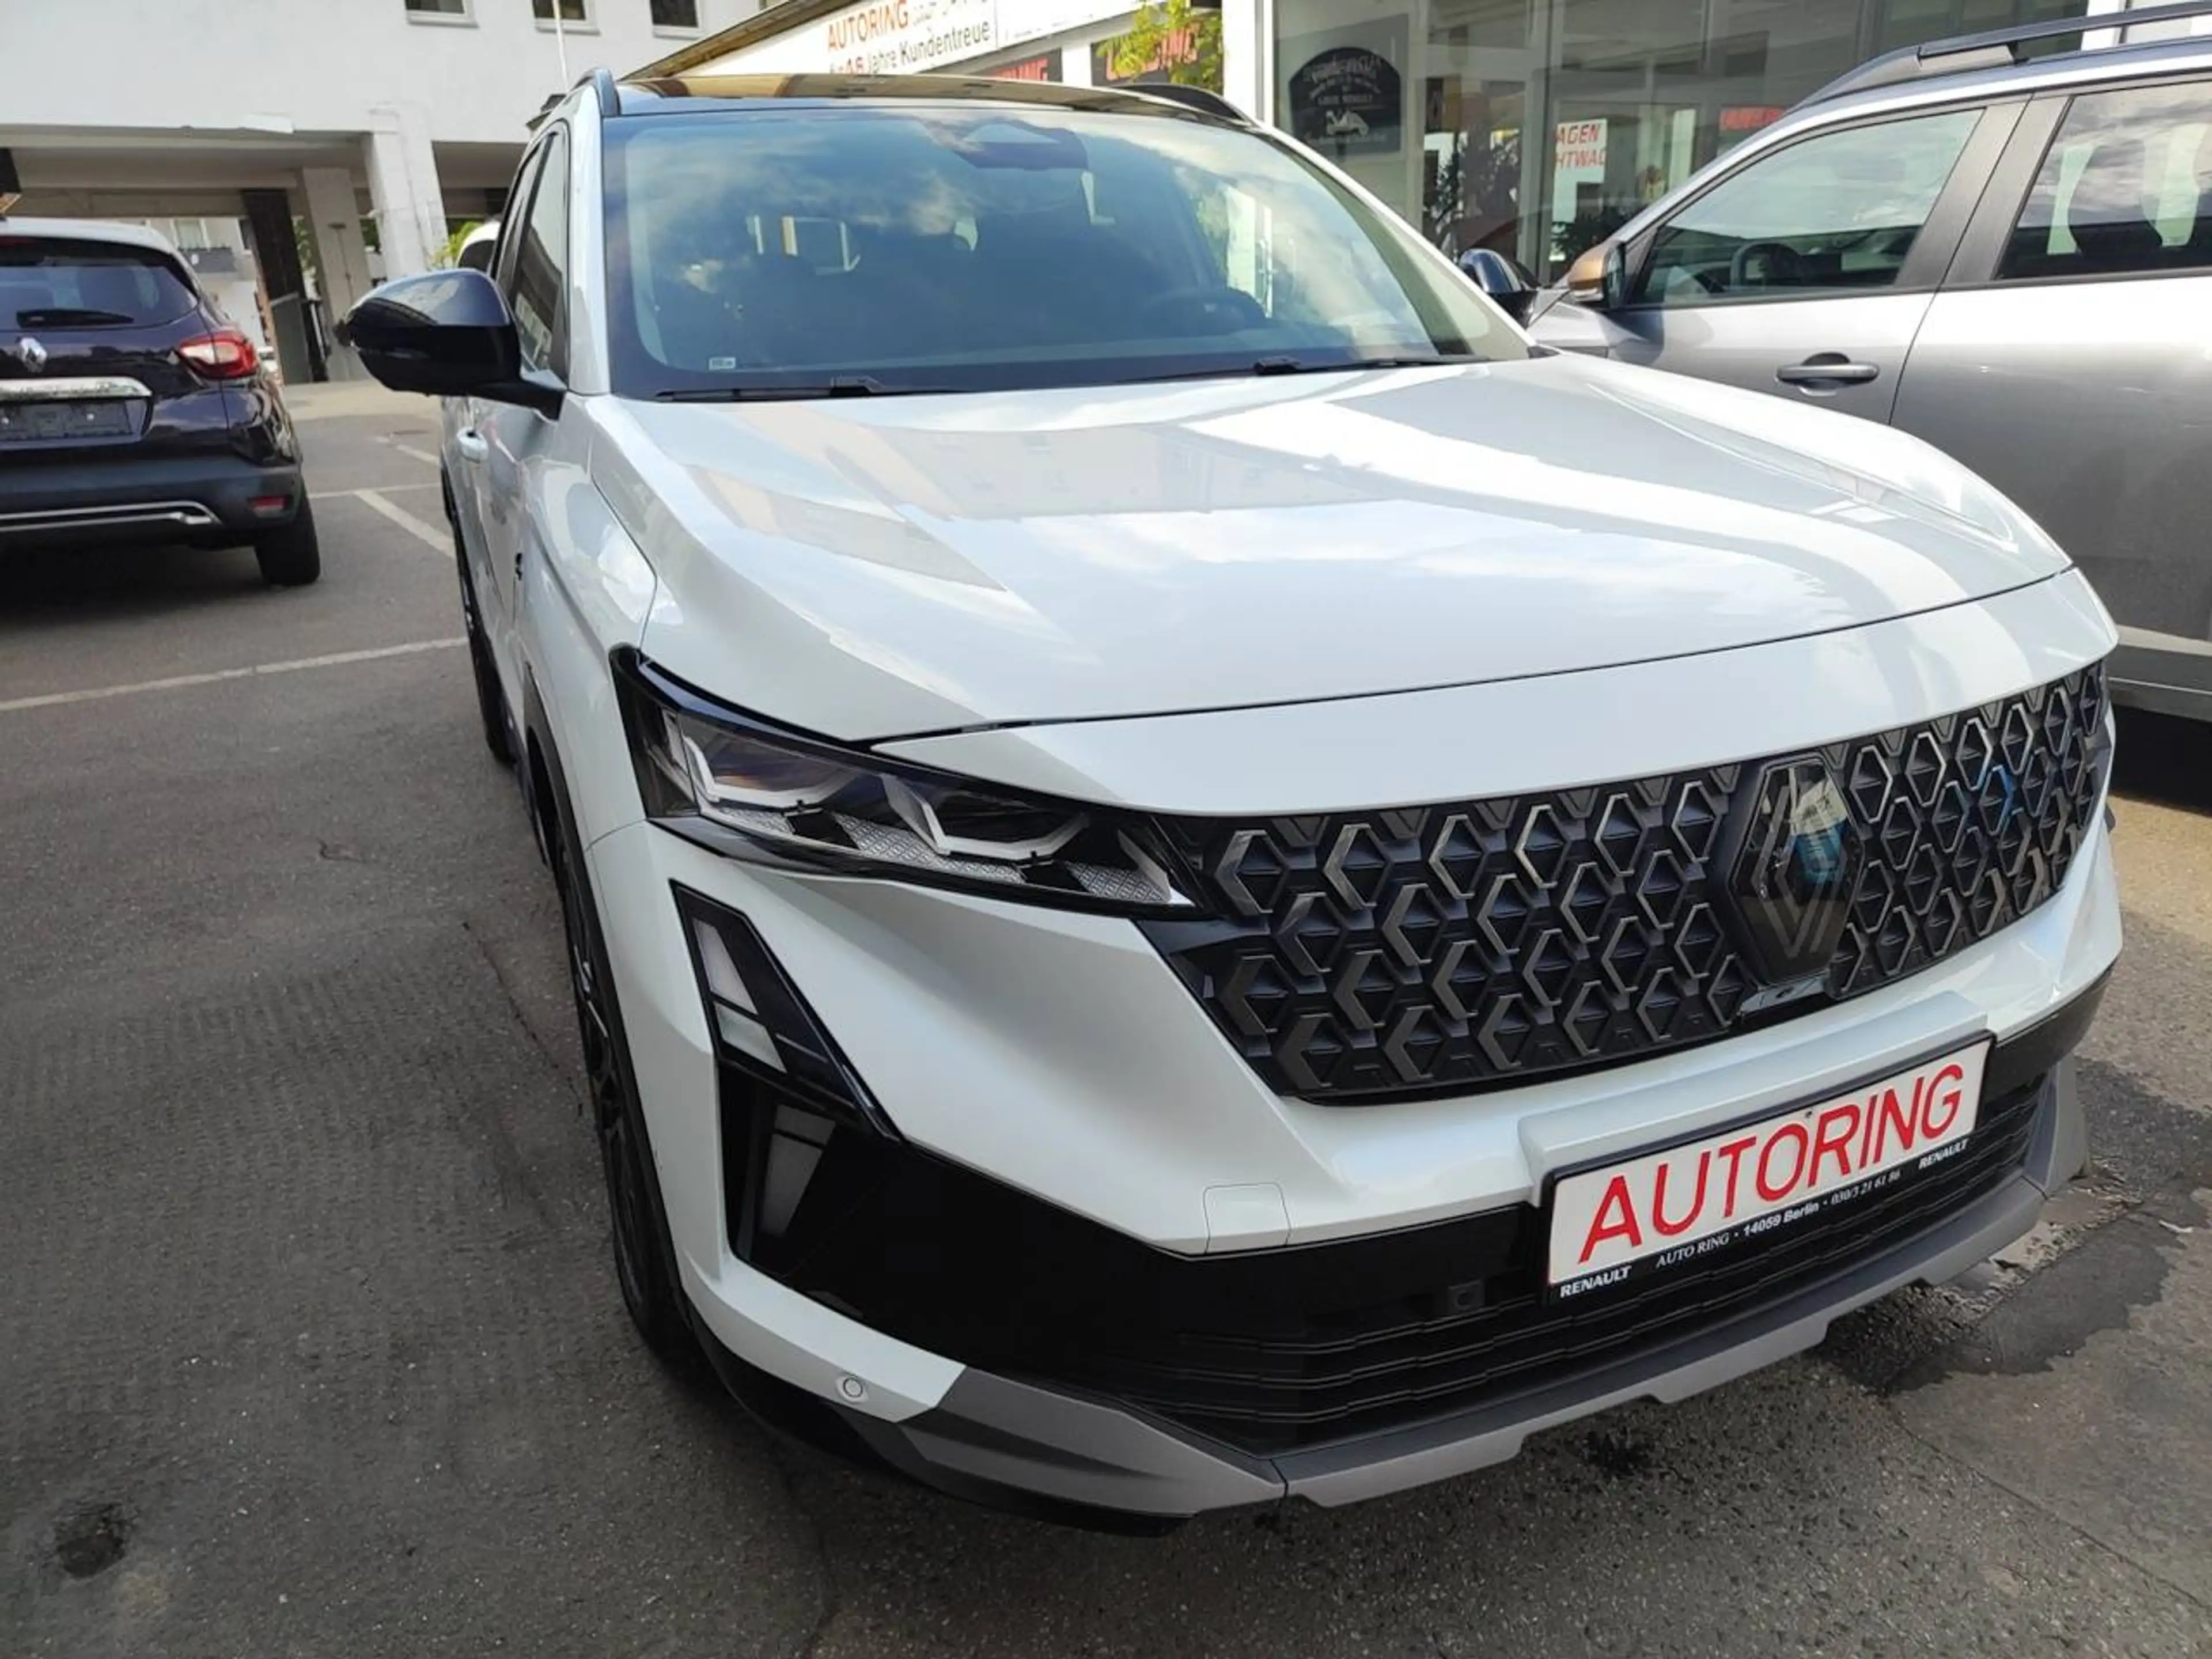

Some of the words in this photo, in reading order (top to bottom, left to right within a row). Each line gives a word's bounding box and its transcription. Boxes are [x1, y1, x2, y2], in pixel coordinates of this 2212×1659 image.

[828, 0, 908, 51] AUTORING
[900, 21, 991, 66] Kundentreue
[1578, 1063, 1964, 1264] AUTORING
[1559, 1265, 1633, 1298] RENAULT
[1655, 1244, 1695, 1268] AUTO
[1696, 1232, 1730, 1254] RING
[1743, 1214, 1782, 1237] 14059
[1783, 1200, 1820, 1224] Berlin
[1918, 1138, 1970, 1170] RENAULT
